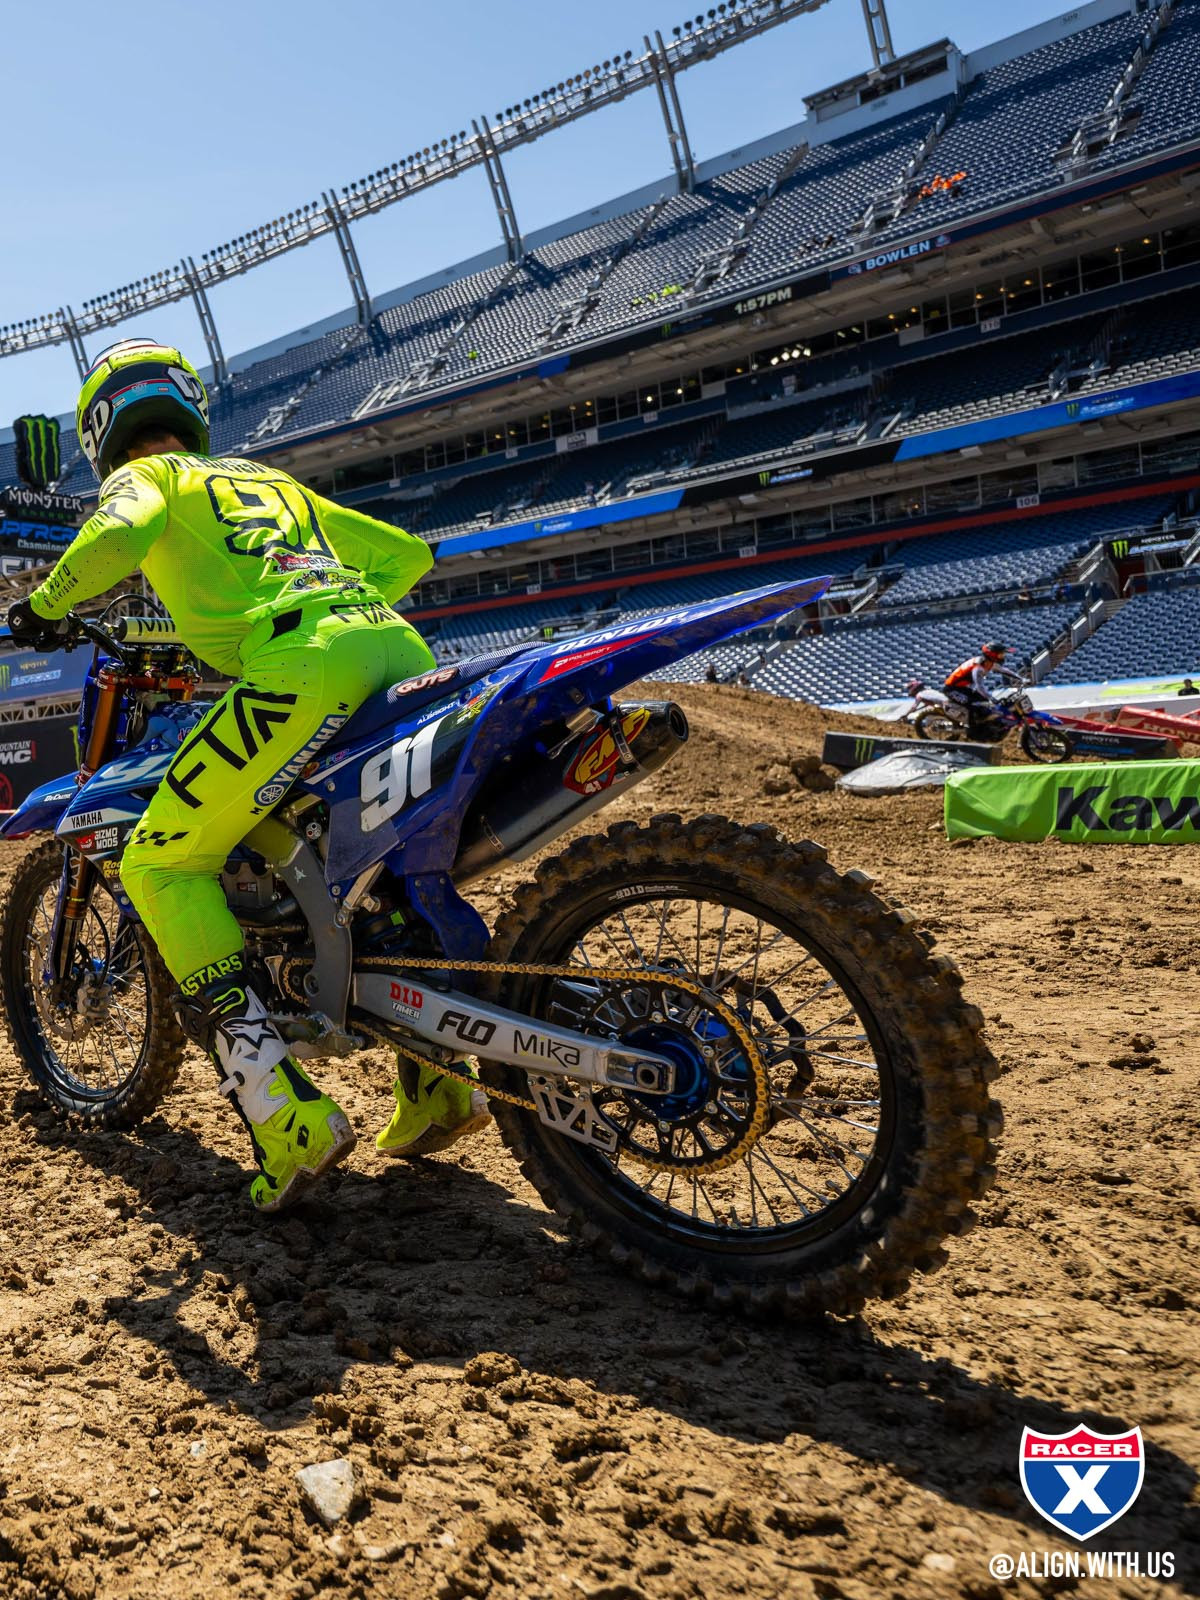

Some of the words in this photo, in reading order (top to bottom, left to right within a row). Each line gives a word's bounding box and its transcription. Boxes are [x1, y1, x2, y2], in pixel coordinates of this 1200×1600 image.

[866, 240, 931, 271] BOWLEN
[734, 287, 793, 315] 1:57PM
[9, 489, 83, 512] MONSTER
[17, 538, 70, 552] Champions
[551, 611, 690, 656] DUNLOP
[567, 646, 612, 662] POLISPORT
[396, 669, 457, 694] GUTS
[416, 700, 458, 726] ALBRIGHT
[273, 717, 347, 782] YAMAHA
[360, 714, 444, 833] 91
[71, 811, 103, 829] YAMAHA
[94, 827, 118, 840] GIZMO
[96, 837, 119, 850] MODS
[103, 860, 121, 870] ROC
[104, 868, 120, 878] RIV
[436, 1009, 497, 1046] FLO
[513, 1029, 580, 1068] Mika
